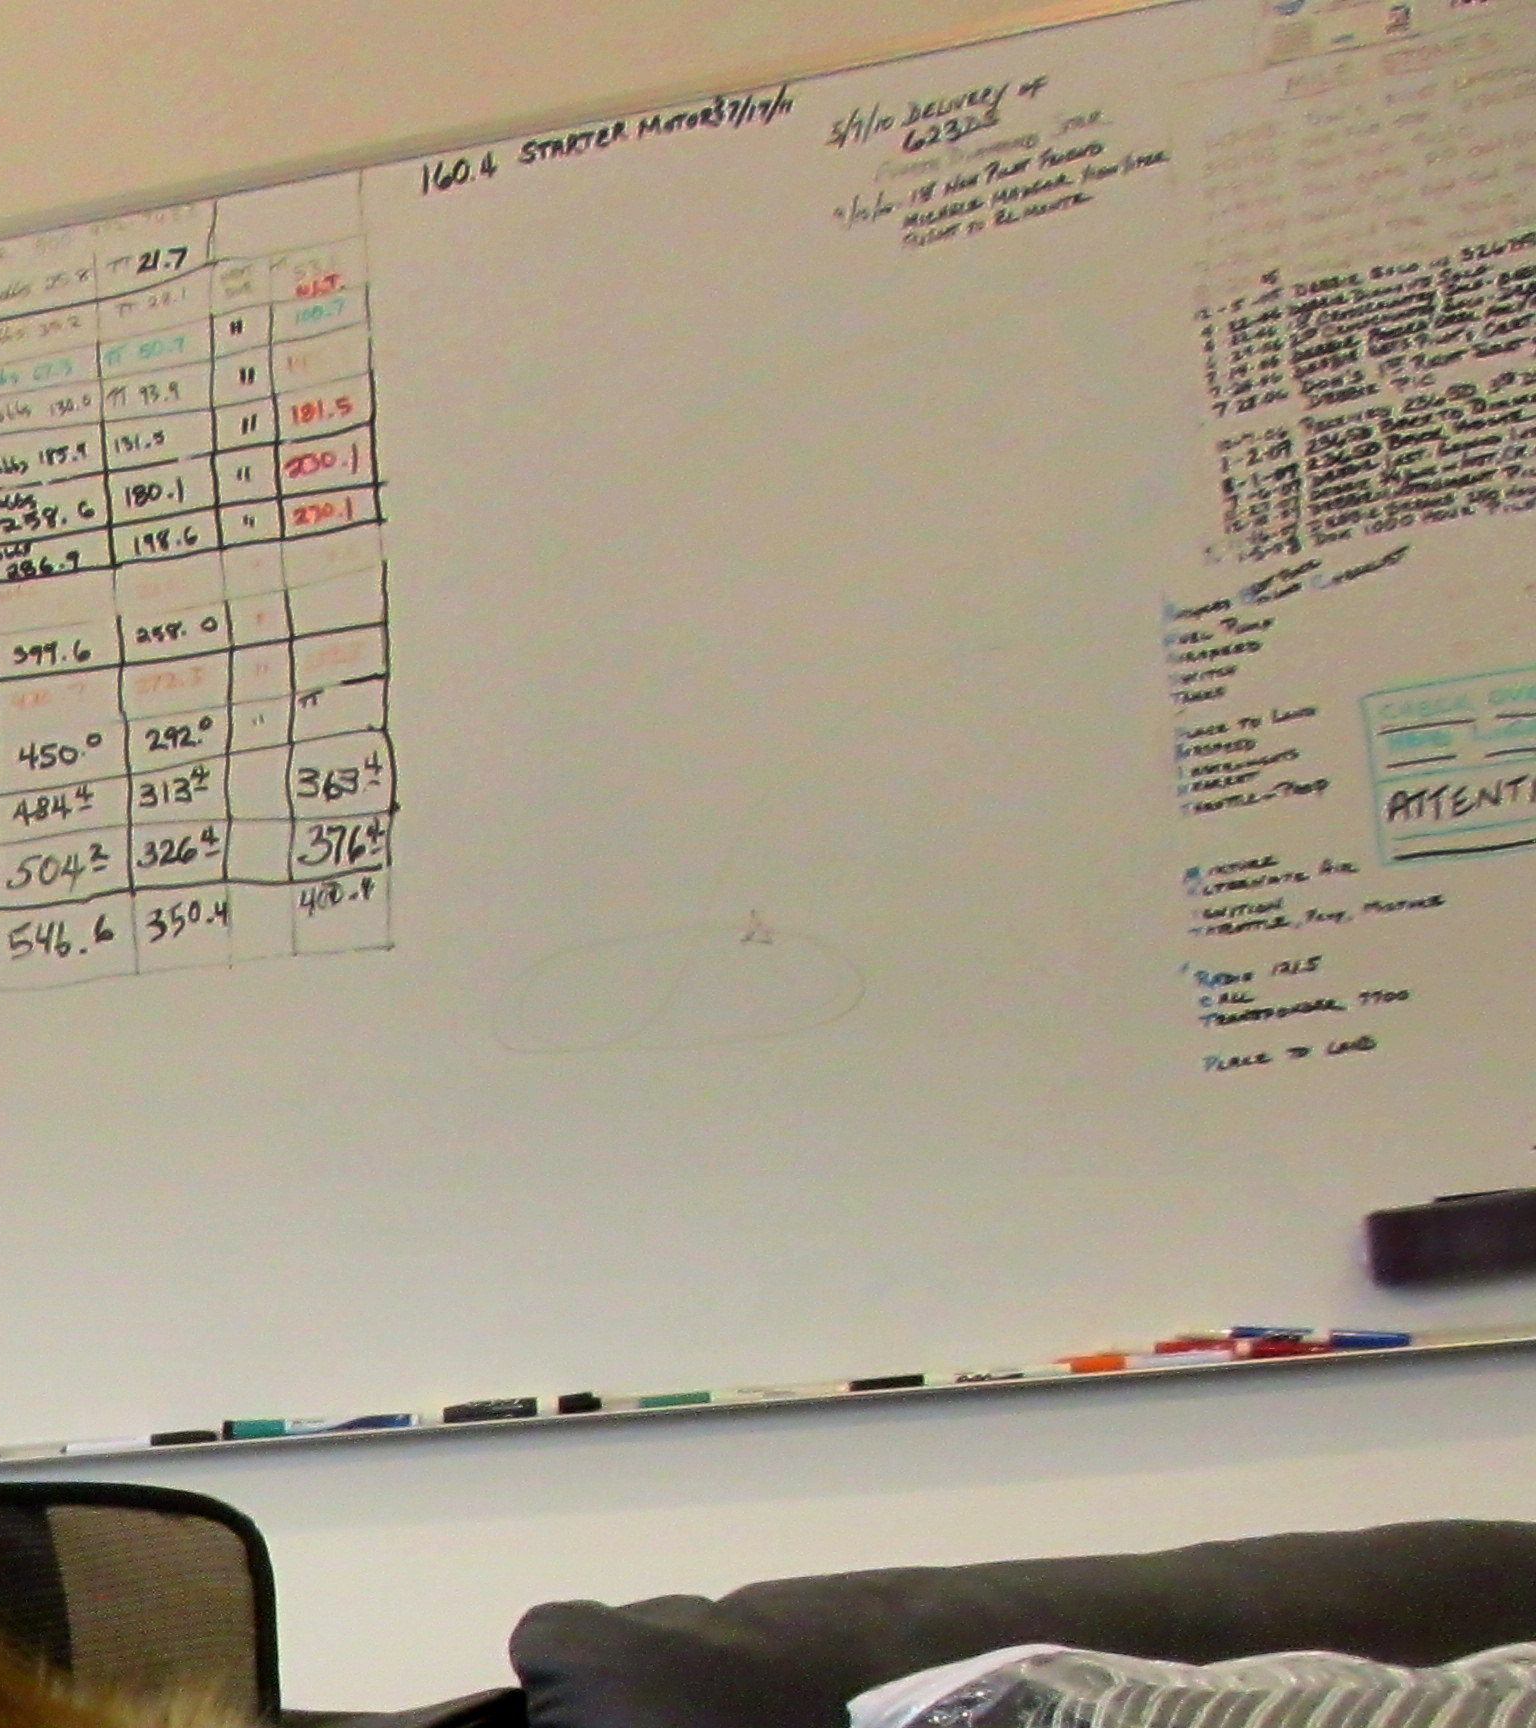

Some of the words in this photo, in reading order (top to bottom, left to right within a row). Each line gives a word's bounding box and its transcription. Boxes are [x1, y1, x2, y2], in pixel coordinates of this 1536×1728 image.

[519, 119, 628, 165] STARTER
[136, 246, 189, 274] 21.7
[125, 476, 184, 508] 180.1
[134, 524, 199, 556] 198.6
